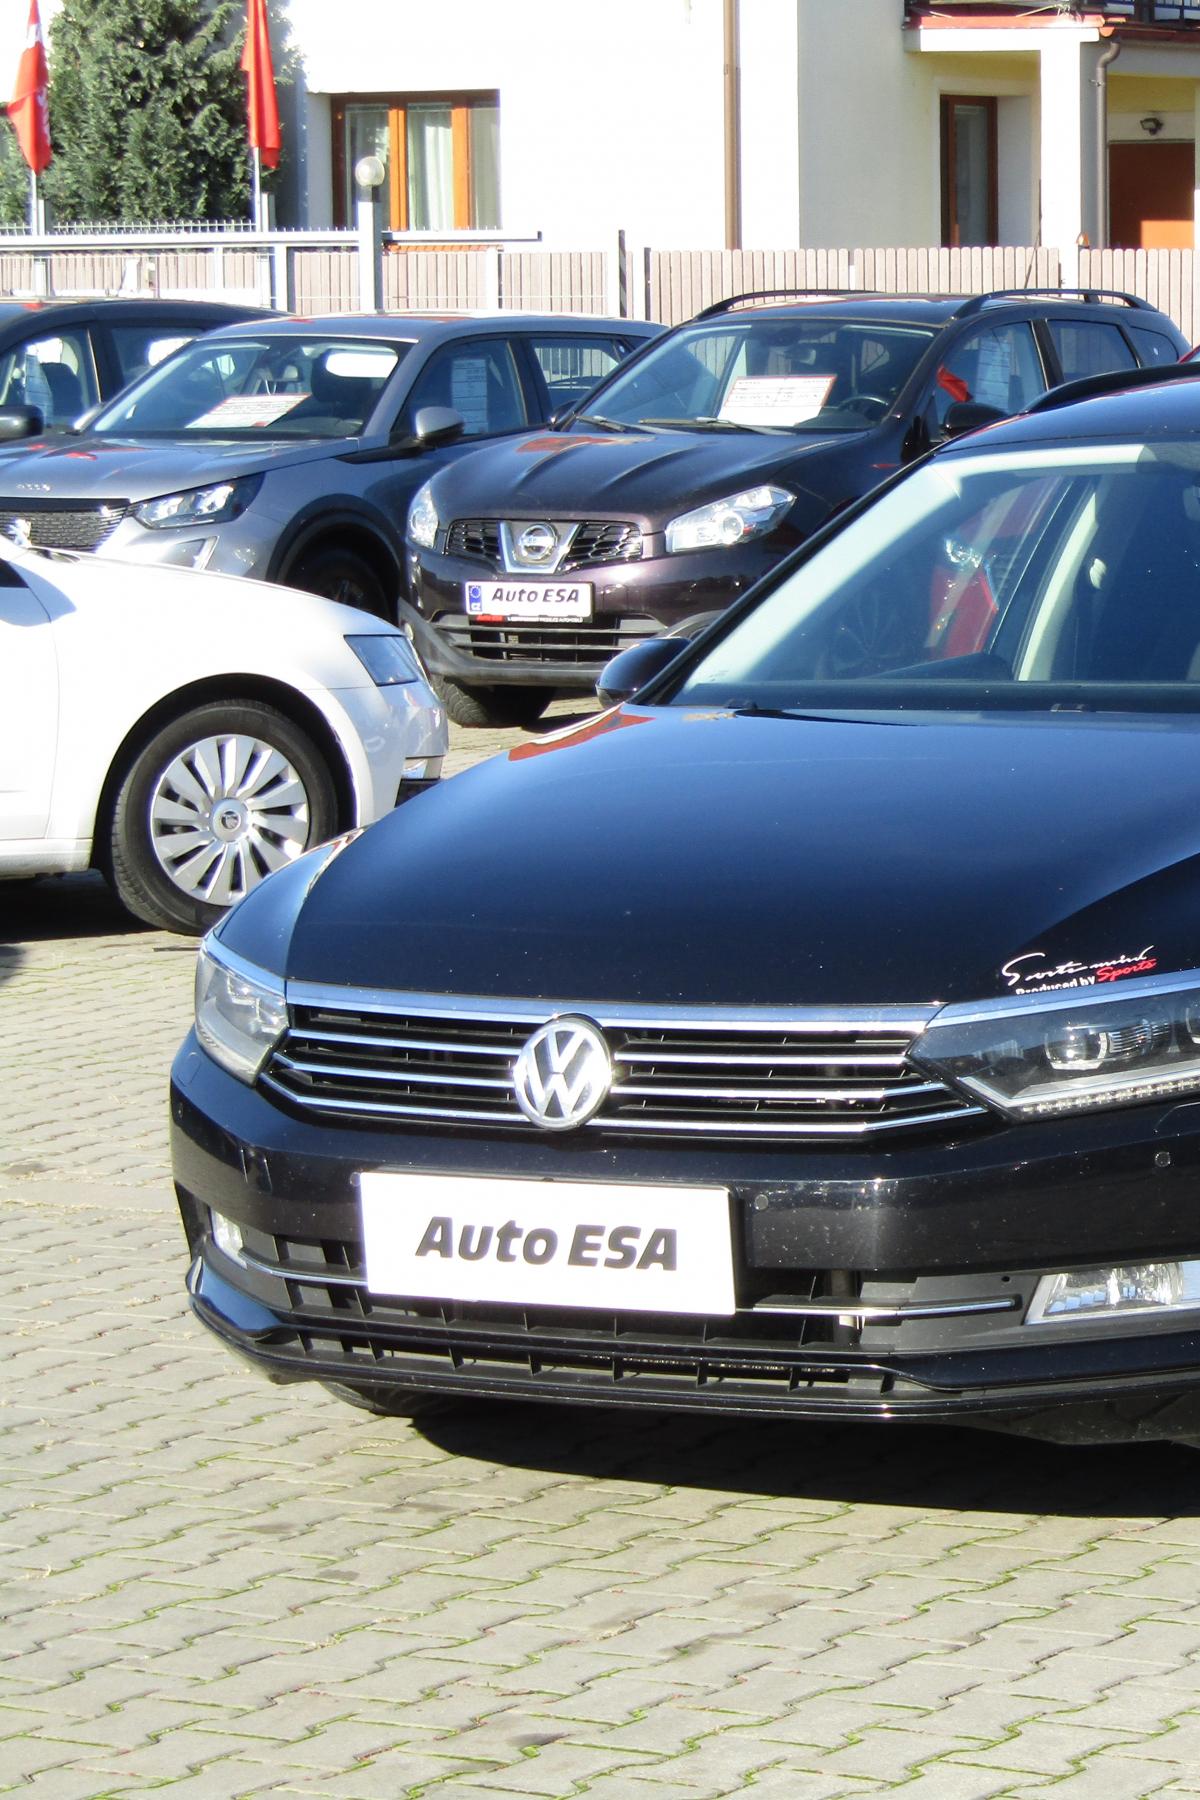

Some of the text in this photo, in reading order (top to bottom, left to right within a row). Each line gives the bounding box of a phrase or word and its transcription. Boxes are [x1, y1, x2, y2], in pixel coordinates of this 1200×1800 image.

[492, 587, 579, 603] Auto ESA
[1096, 958, 1157, 982] Sports
[415, 1216, 678, 1271] Auto ESA
